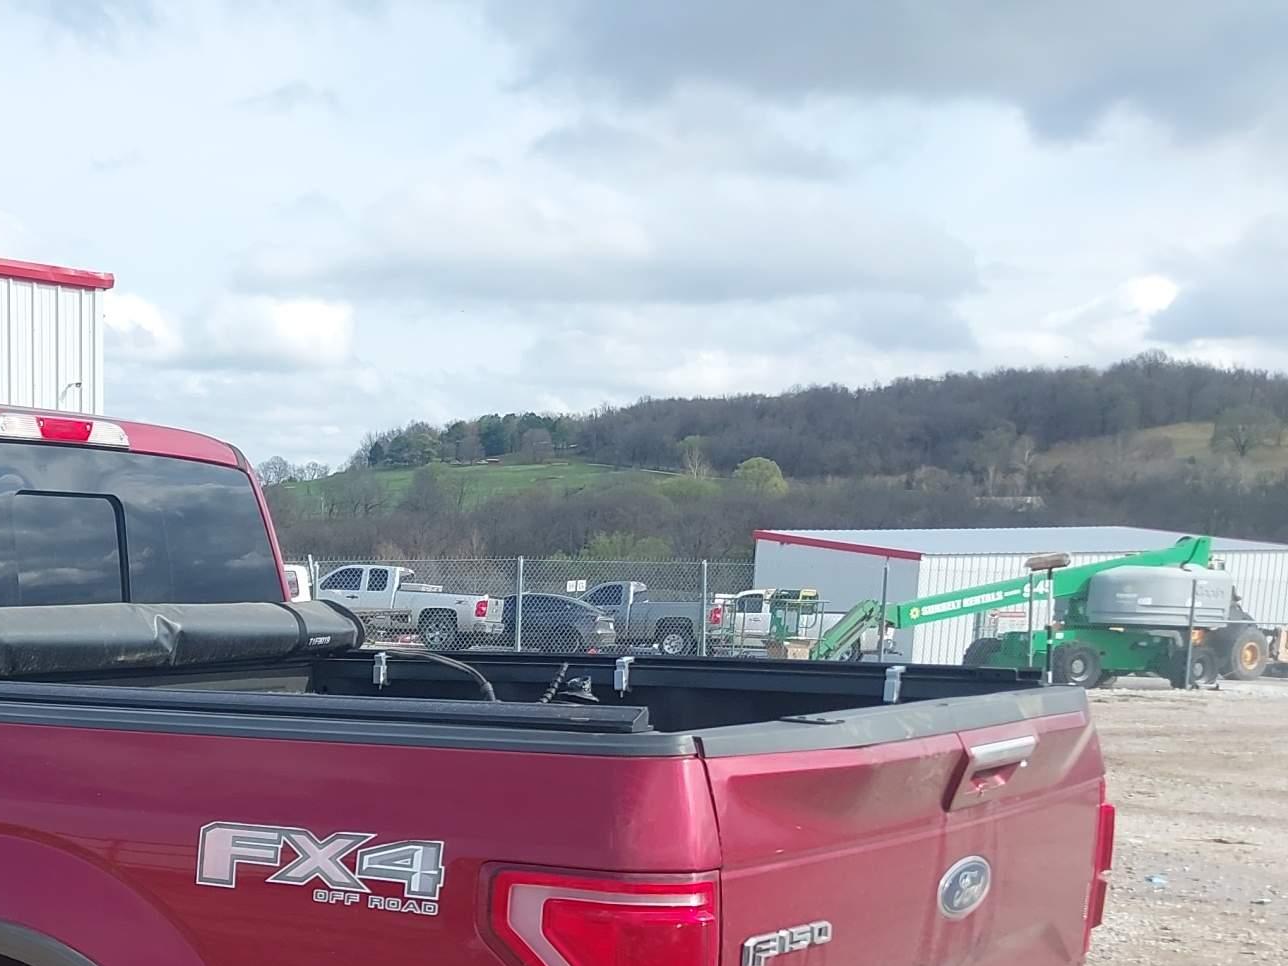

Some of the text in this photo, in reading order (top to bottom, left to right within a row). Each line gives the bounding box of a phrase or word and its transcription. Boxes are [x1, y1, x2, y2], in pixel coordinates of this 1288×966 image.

[196, 821, 445, 900] FX4
[312, 889, 439, 916] OFF ROAD
